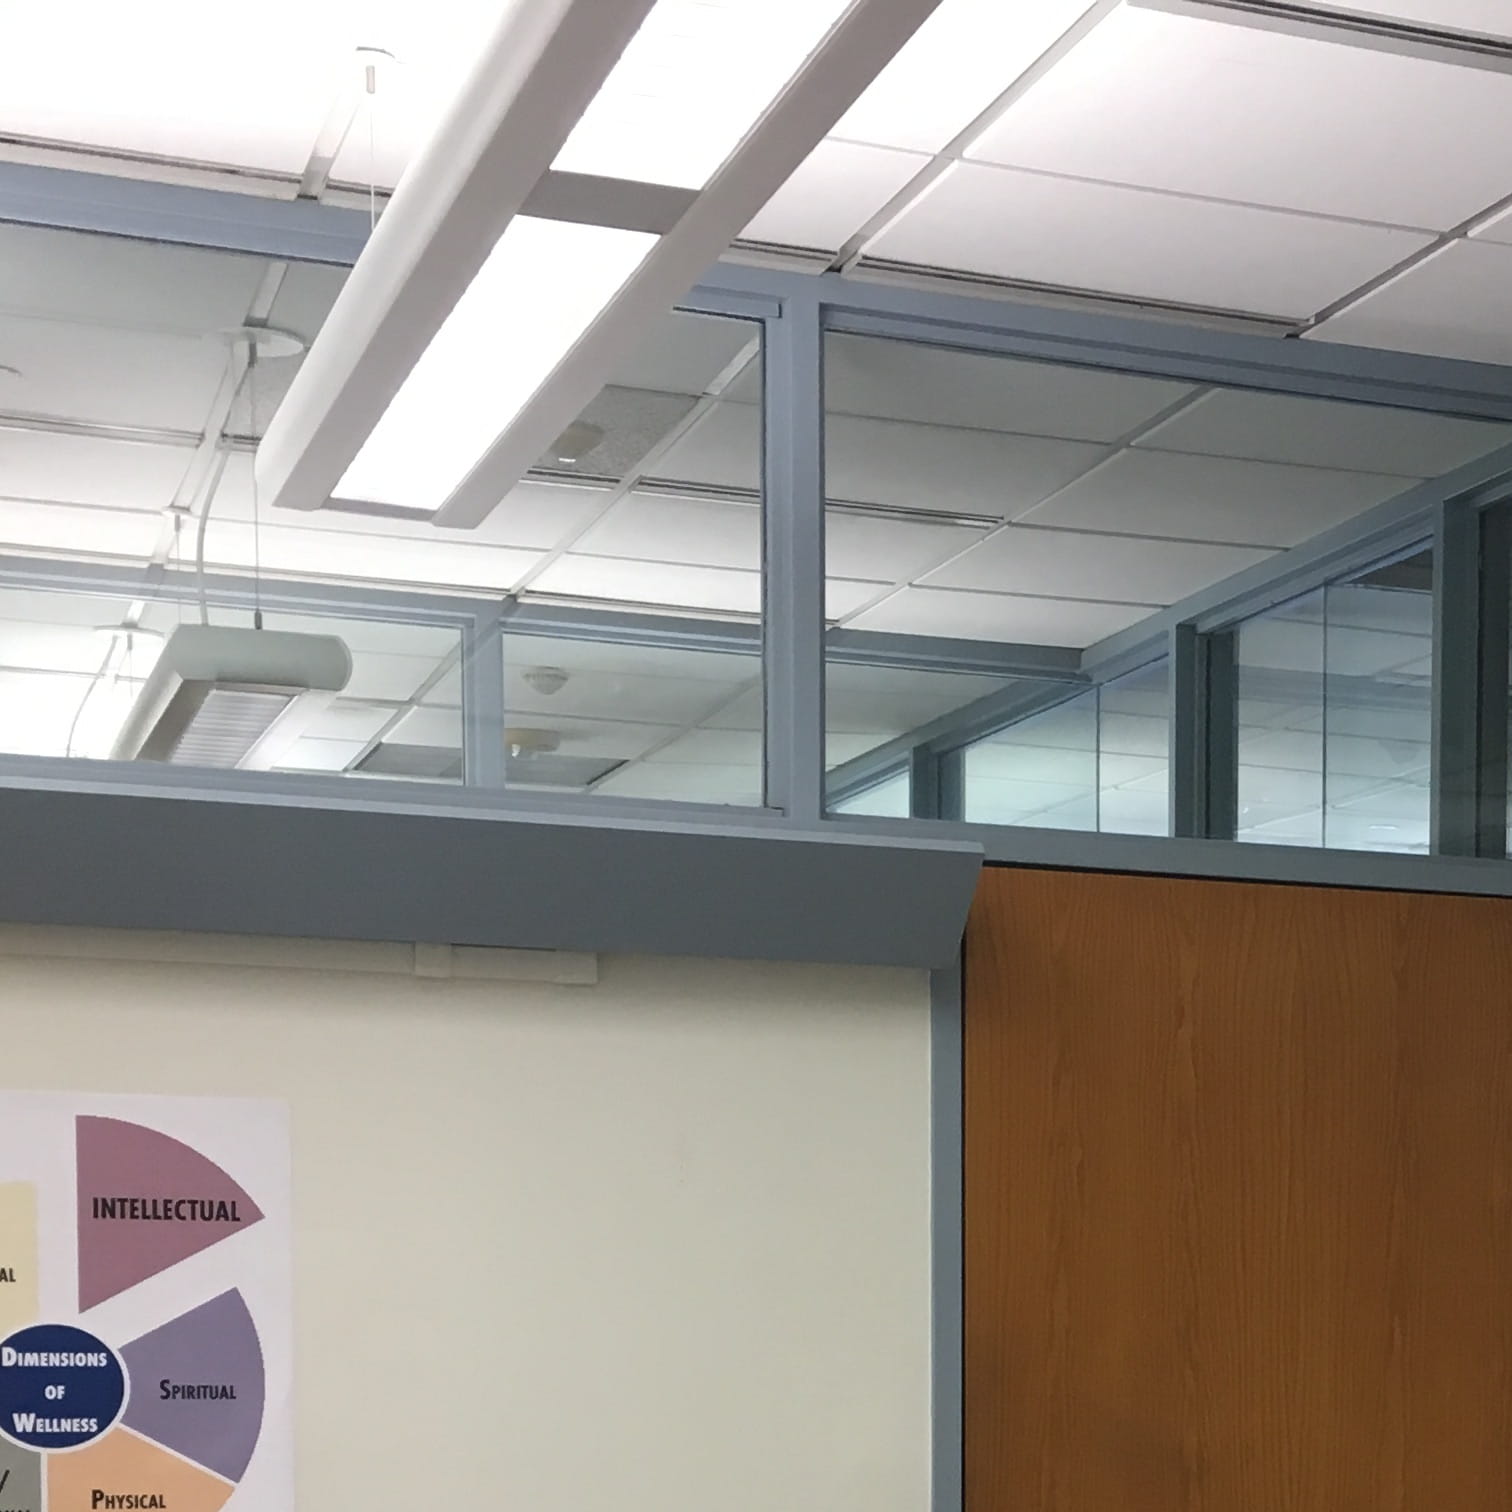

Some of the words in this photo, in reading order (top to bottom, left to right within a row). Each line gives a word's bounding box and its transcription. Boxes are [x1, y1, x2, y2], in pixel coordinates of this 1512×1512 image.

[92, 1197, 240, 1223] INTELLECTUAL
[2, 1346, 107, 1367] DIMENSIONS
[44, 1385, 65, 1400] OF
[159, 1380, 237, 1401] SPIRITUAL
[12, 1412, 98, 1433] WELLNESS
[91, 1489, 166, 1510] PHYSICAL
